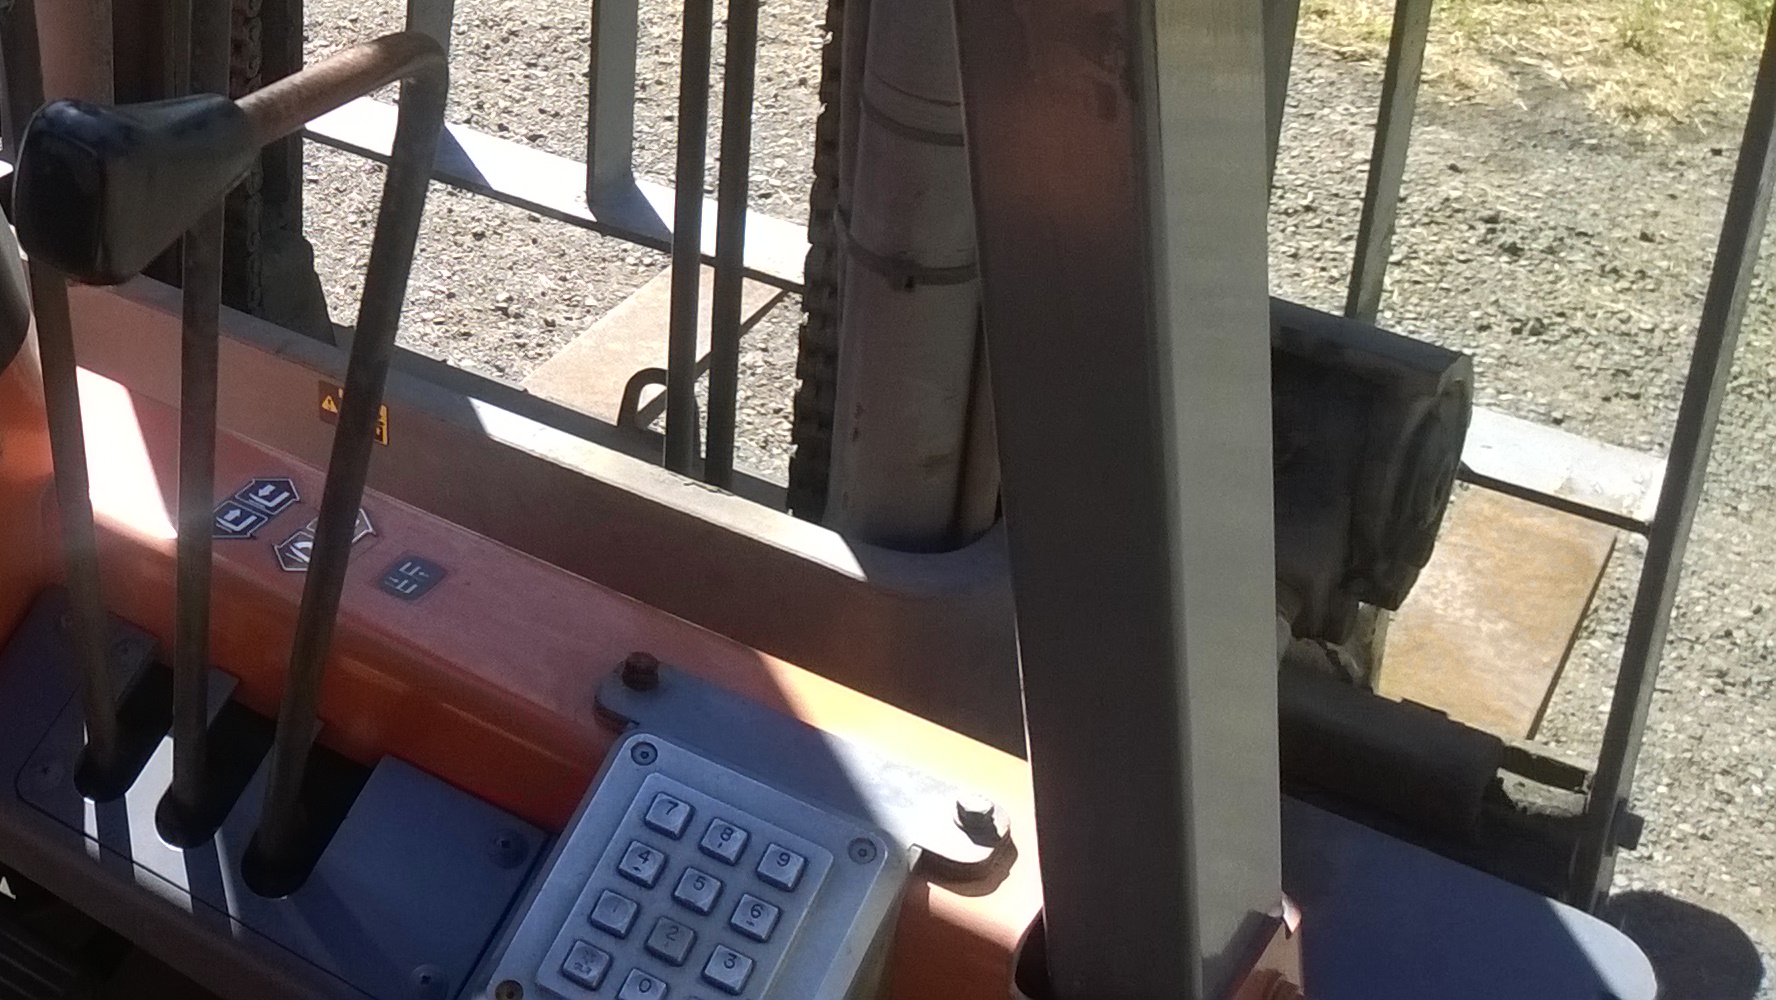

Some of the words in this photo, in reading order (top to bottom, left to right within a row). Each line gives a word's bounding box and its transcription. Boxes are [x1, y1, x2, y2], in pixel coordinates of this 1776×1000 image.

[666, 800, 679, 816] 7
[720, 827, 734, 842] 8
[776, 852, 791, 868] 9
[637, 850, 650, 865] 4
[692, 876, 706, 891] 5
[750, 903, 763, 919] 6
[665, 926, 680, 942] 2
[722, 953, 737, 970] 3
[638, 978, 652, 993] 0
